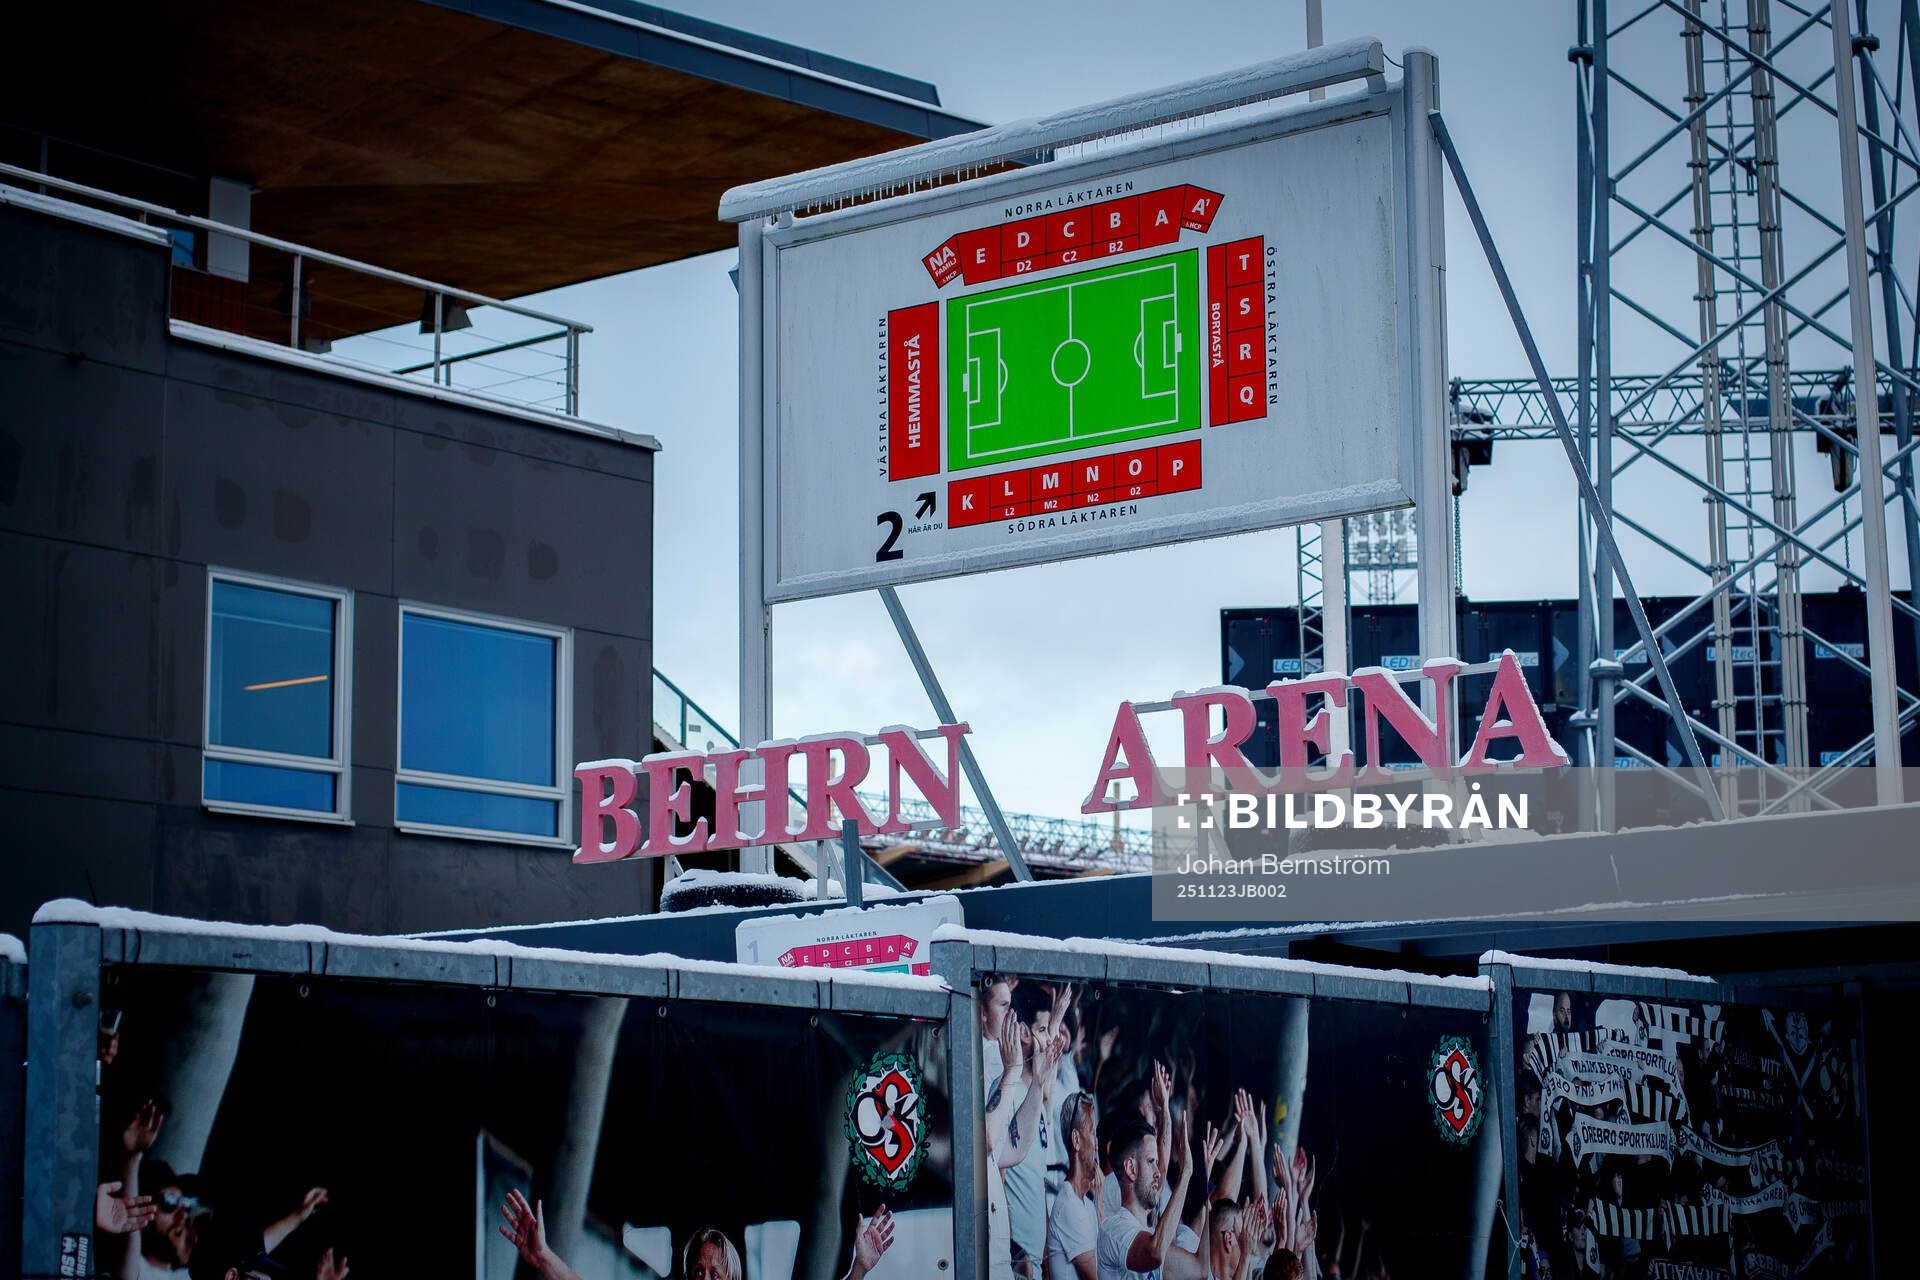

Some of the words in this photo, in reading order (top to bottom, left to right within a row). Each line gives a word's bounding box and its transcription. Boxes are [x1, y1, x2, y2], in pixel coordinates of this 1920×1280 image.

[1005, 200, 1053, 218] NORRA
[1058, 181, 1133, 206] LÄKTAREN
[976, 247, 987, 264] E
[1017, 231, 1030, 248] D
[1063, 221, 1075, 238] C
[1110, 212, 1121, 229] B
[1155, 209, 1169, 226] A
[929, 245, 956, 271] NA
[934, 257, 957, 277] FAMILJ
[1016, 260, 1032, 273] D2
[1062, 250, 1077, 263] C2
[1109, 240, 1124, 253] B2
[1239, 253, 1250, 271] T
[1266, 246, 1278, 304] ÖSTRA
[1239, 297, 1251, 316] S
[1211, 302, 1225, 368] BORTASTÅ
[1239, 343, 1252, 361] R
[876, 317, 887, 405] LÄKTAREN
[1267, 311, 1280, 405] LÄKTAREN
[903, 334, 921, 449] HEMMASTÅ
[1239, 386, 1254, 406] Q
[877, 410, 888, 477] VÄSTRA
[962, 493, 974, 511] K
[1004, 480, 1014, 496] L
[1042, 472, 1059, 490] M
[1086, 465, 1099, 483] N
[1128, 458, 1142, 476] O
[1172, 459, 1184, 476] P
[1005, 507, 1015, 516] L2
[1044, 499, 1058, 510] M2
[1087, 493, 1099, 503] N2
[1008, 517, 1056, 534] SÖDRA
[1061, 504, 1138, 526] LÄKTAREN
[876, 511, 904, 562] 2
[933, 522, 943, 531] DU
[1081, 650, 1570, 814] ARENA
[573, 722, 972, 864] BEHRN
[823, 949, 830, 957] D
[844, 946, 851, 955] C
[866, 944, 872, 952] B
[887, 945, 894, 953] A
[1581, 1121, 1617, 1146] ÖREBRO
